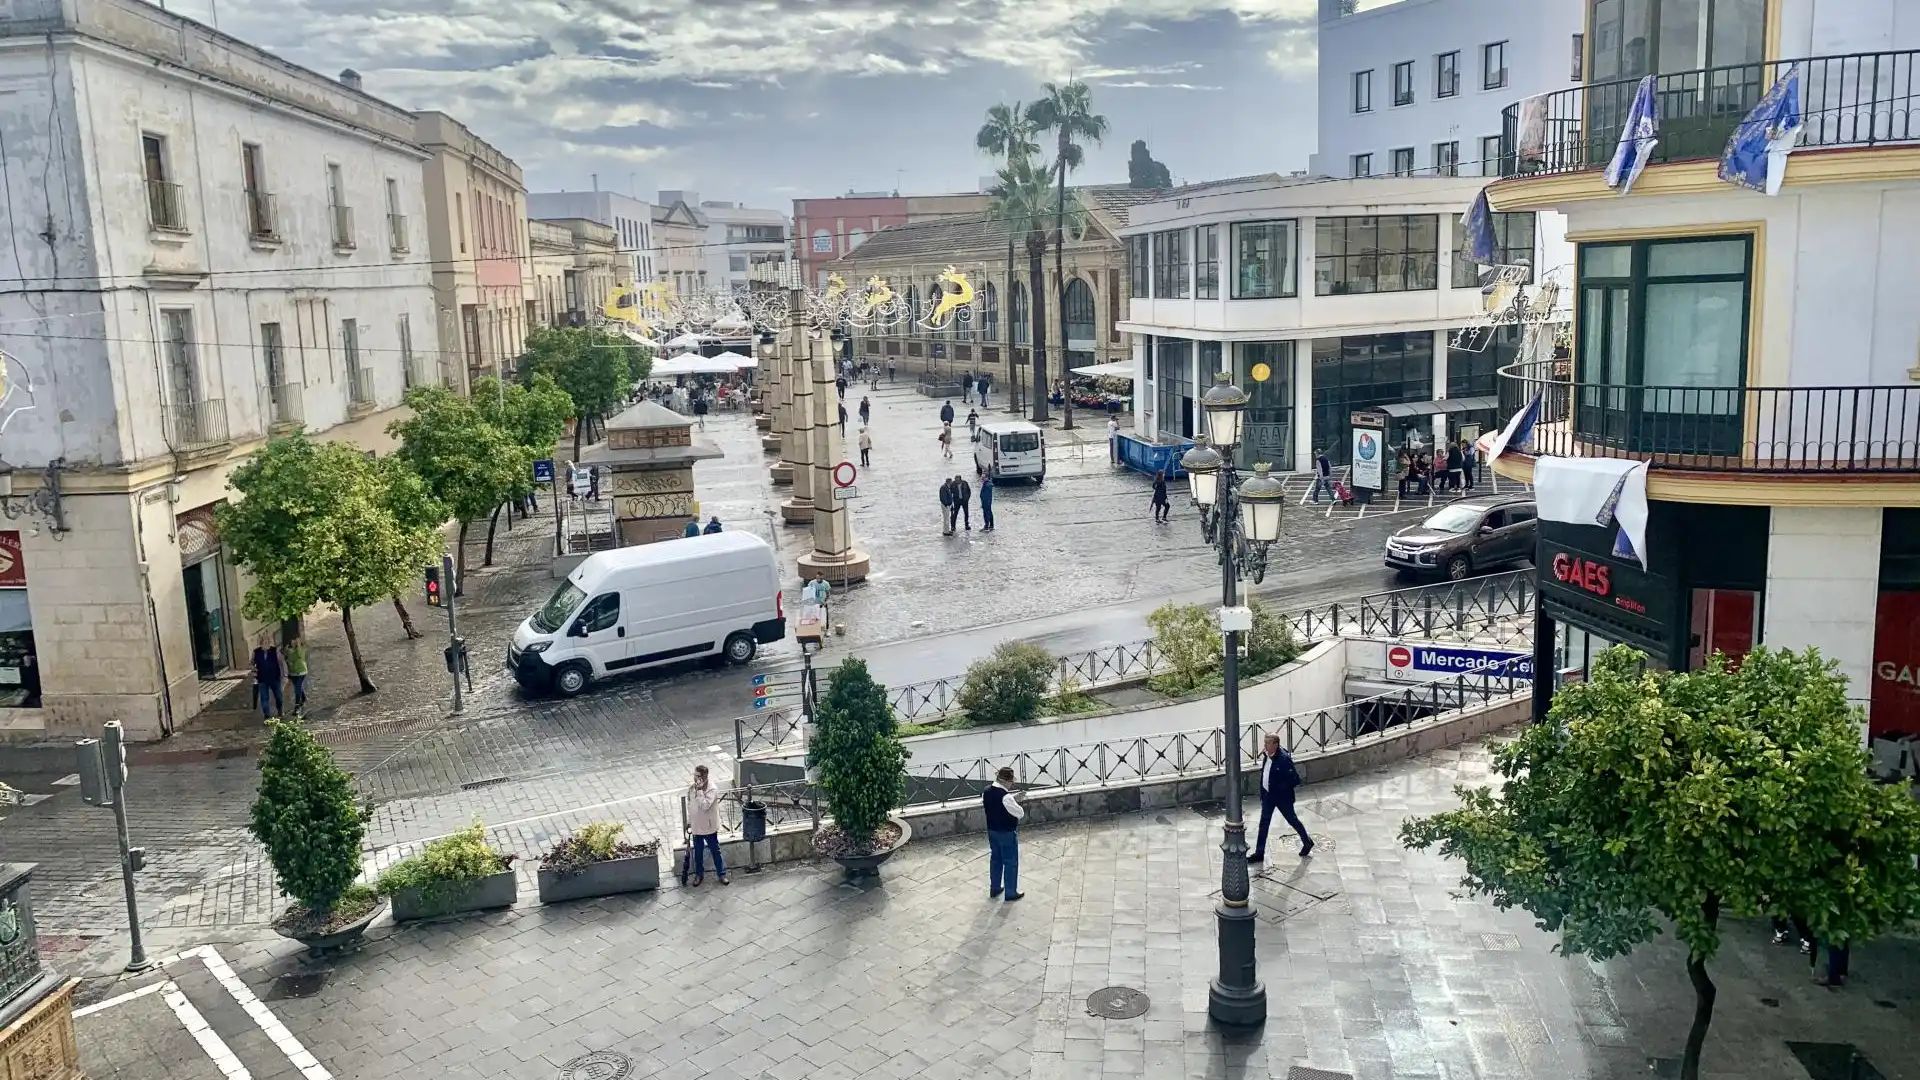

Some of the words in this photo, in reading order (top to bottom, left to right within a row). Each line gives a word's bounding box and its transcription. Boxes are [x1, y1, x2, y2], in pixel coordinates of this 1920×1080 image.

[1552, 552, 1611, 596] GAES
[1421, 651, 1500, 671] Mercado
[1877, 661, 1920, 687] GA
